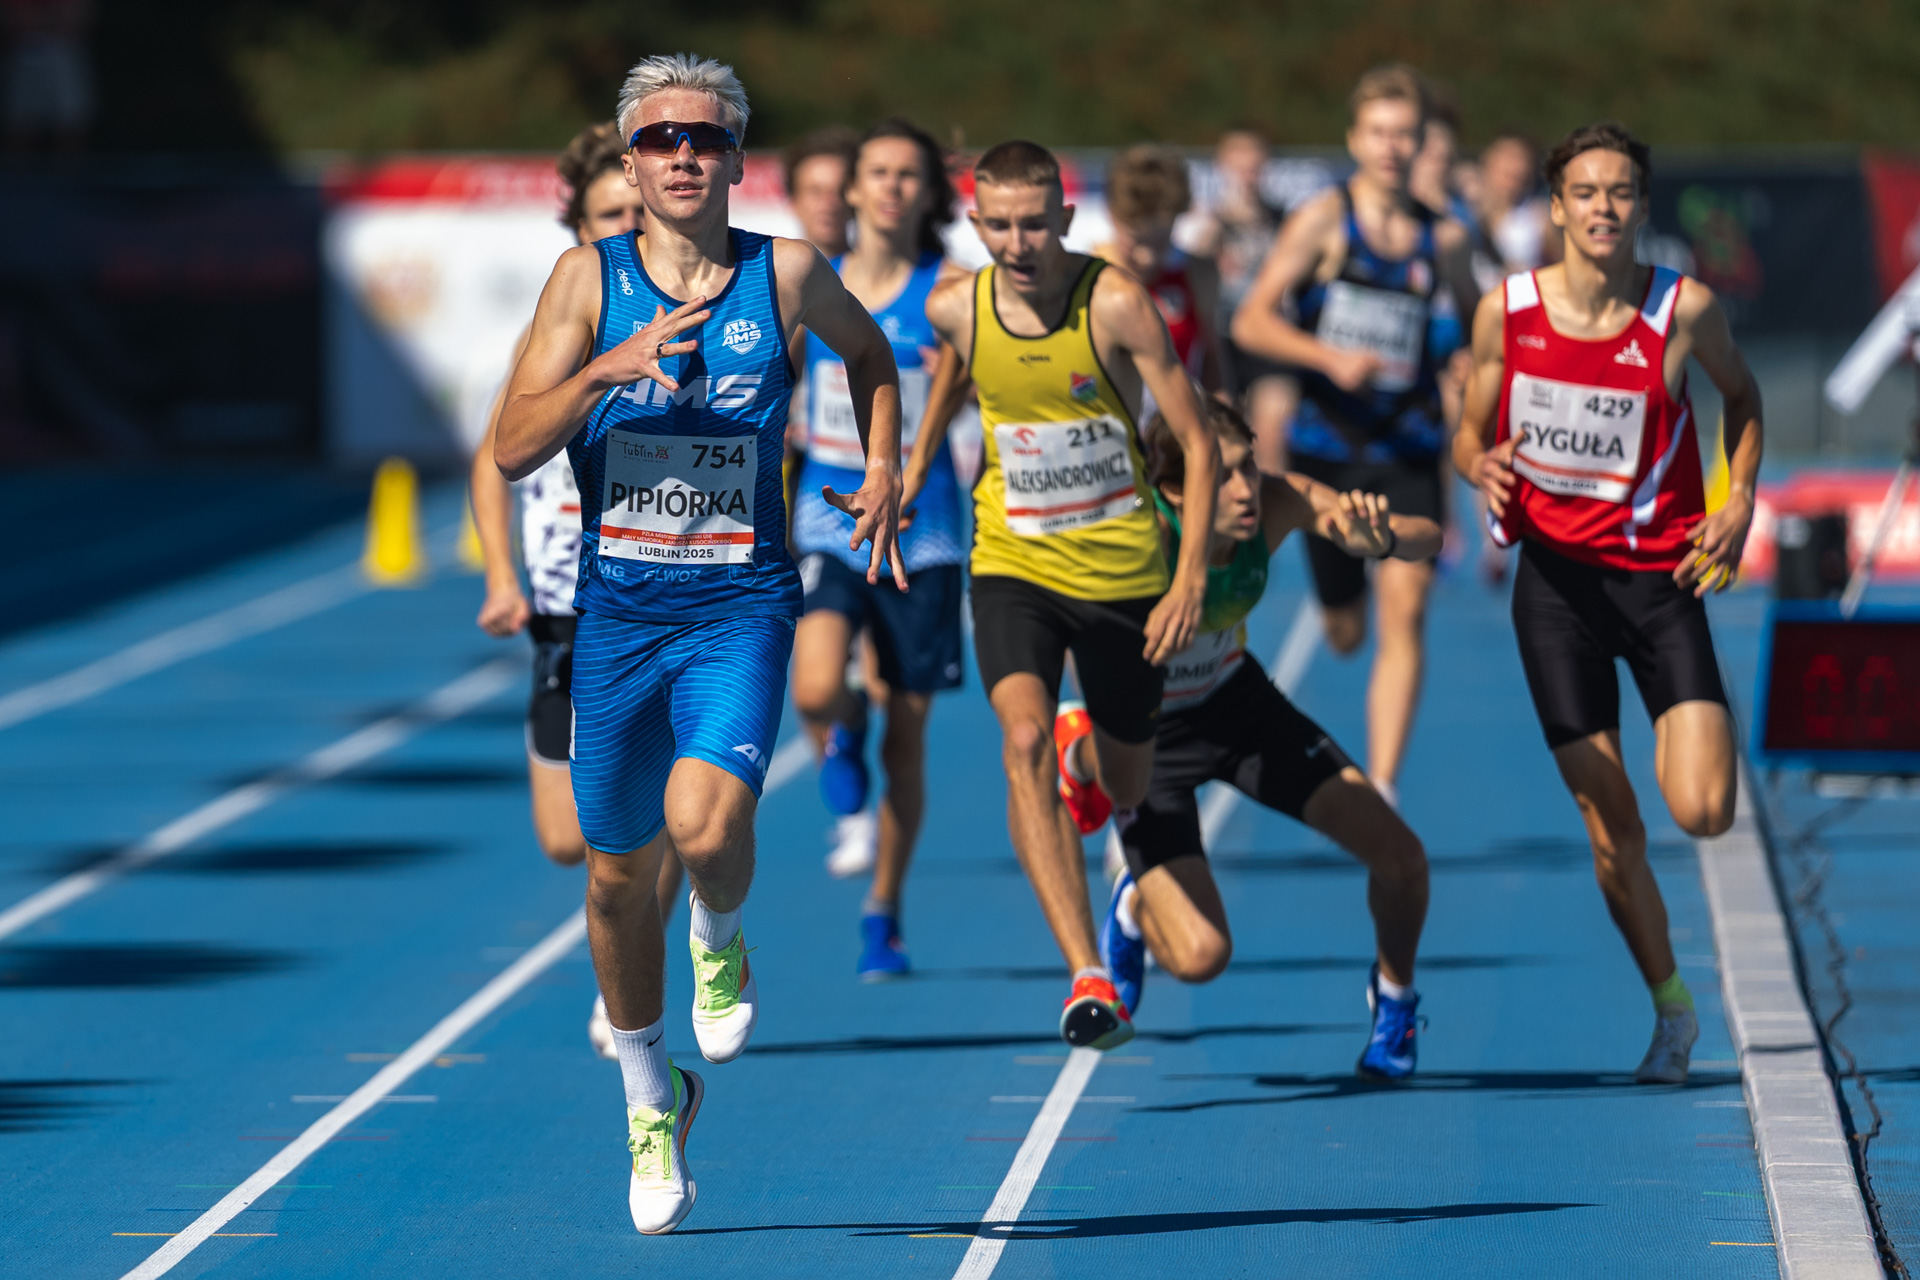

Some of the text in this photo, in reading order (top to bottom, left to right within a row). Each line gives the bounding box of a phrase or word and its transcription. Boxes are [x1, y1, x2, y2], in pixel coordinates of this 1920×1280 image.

[617, 268, 634, 296] deep
[721, 329, 762, 347] AMS
[605, 374, 763, 409] AMS
[1584, 394, 1634, 418] 429
[1520, 421, 1625, 460] SYGUŁA
[691, 444, 746, 469] 754
[1008, 452, 1127, 494] ALEKSANDROWICZ
[610, 482, 748, 518] PIPIÓRKA
[638, 545, 714, 559] LUBLIN 2025
